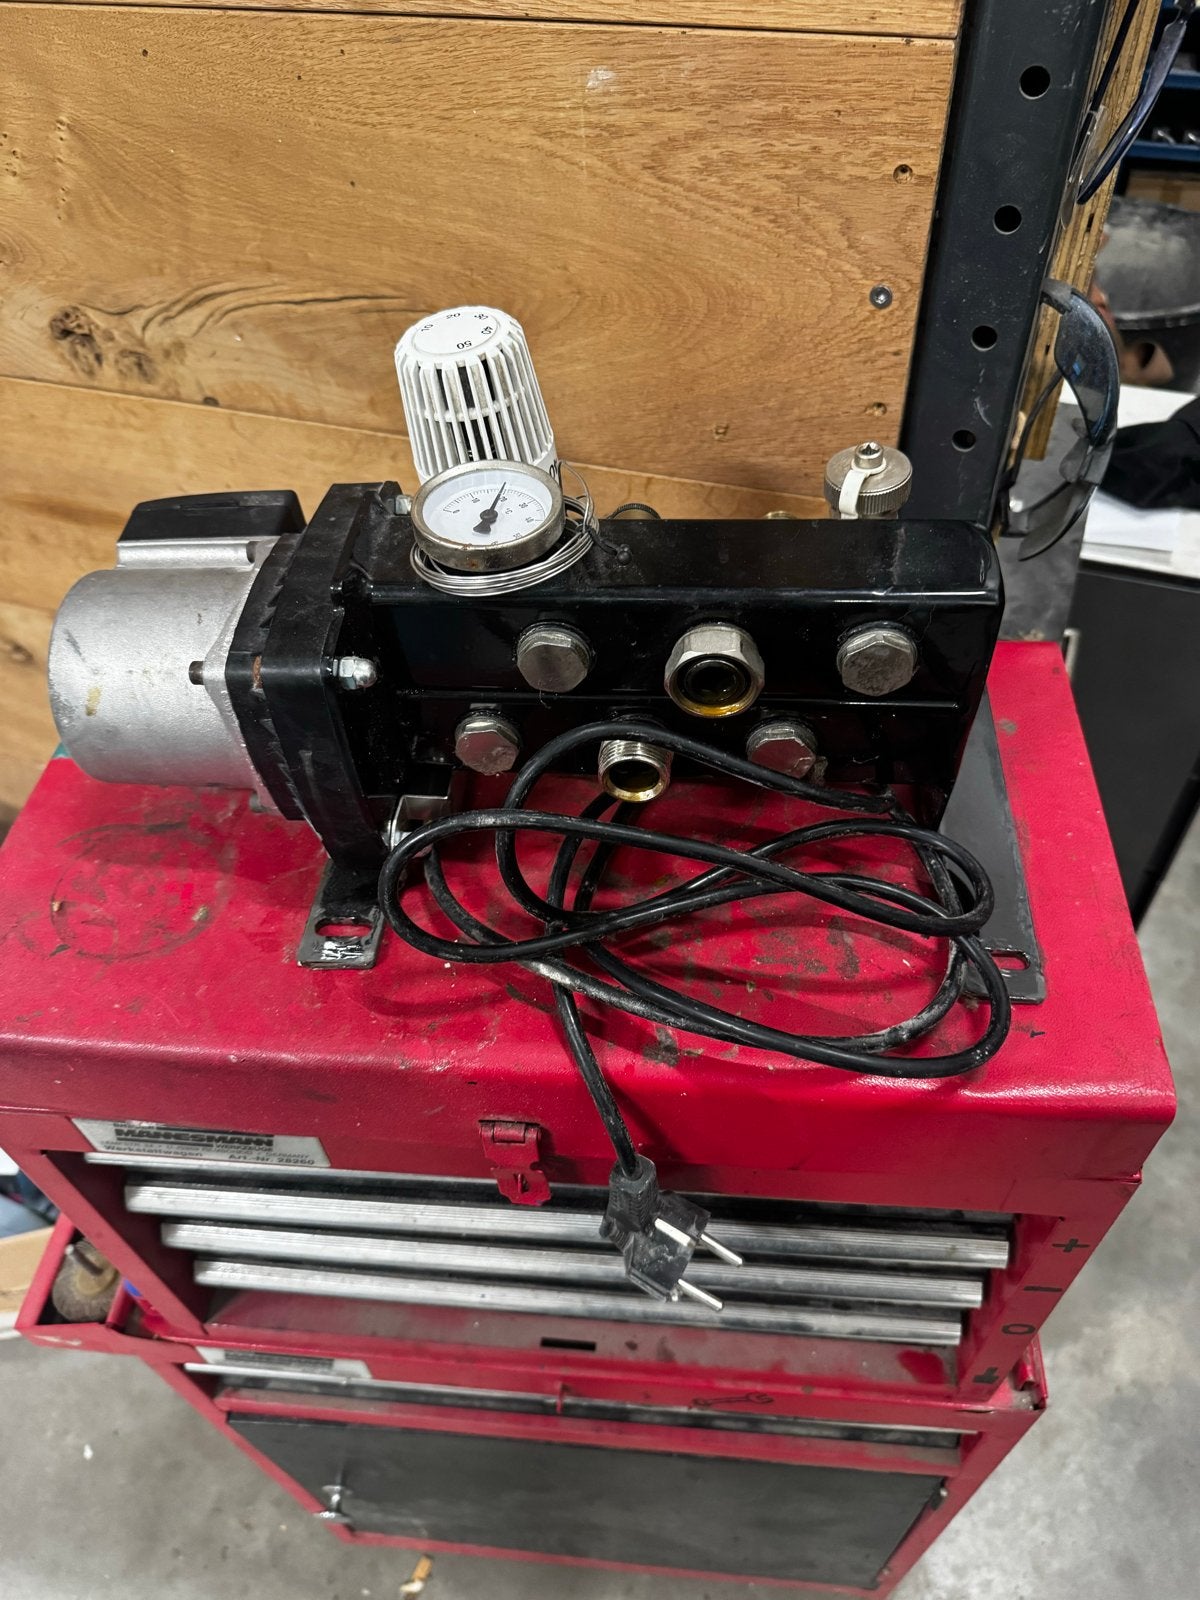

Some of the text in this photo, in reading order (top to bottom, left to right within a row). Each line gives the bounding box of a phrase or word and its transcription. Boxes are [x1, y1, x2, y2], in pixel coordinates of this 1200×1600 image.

[421, 324, 434, 332] 10
[456, 340, 472, 350] 50
[114, 1128, 274, 1147] MANNESMANN
[104, 1144, 203, 1156] Werkstattwagen
